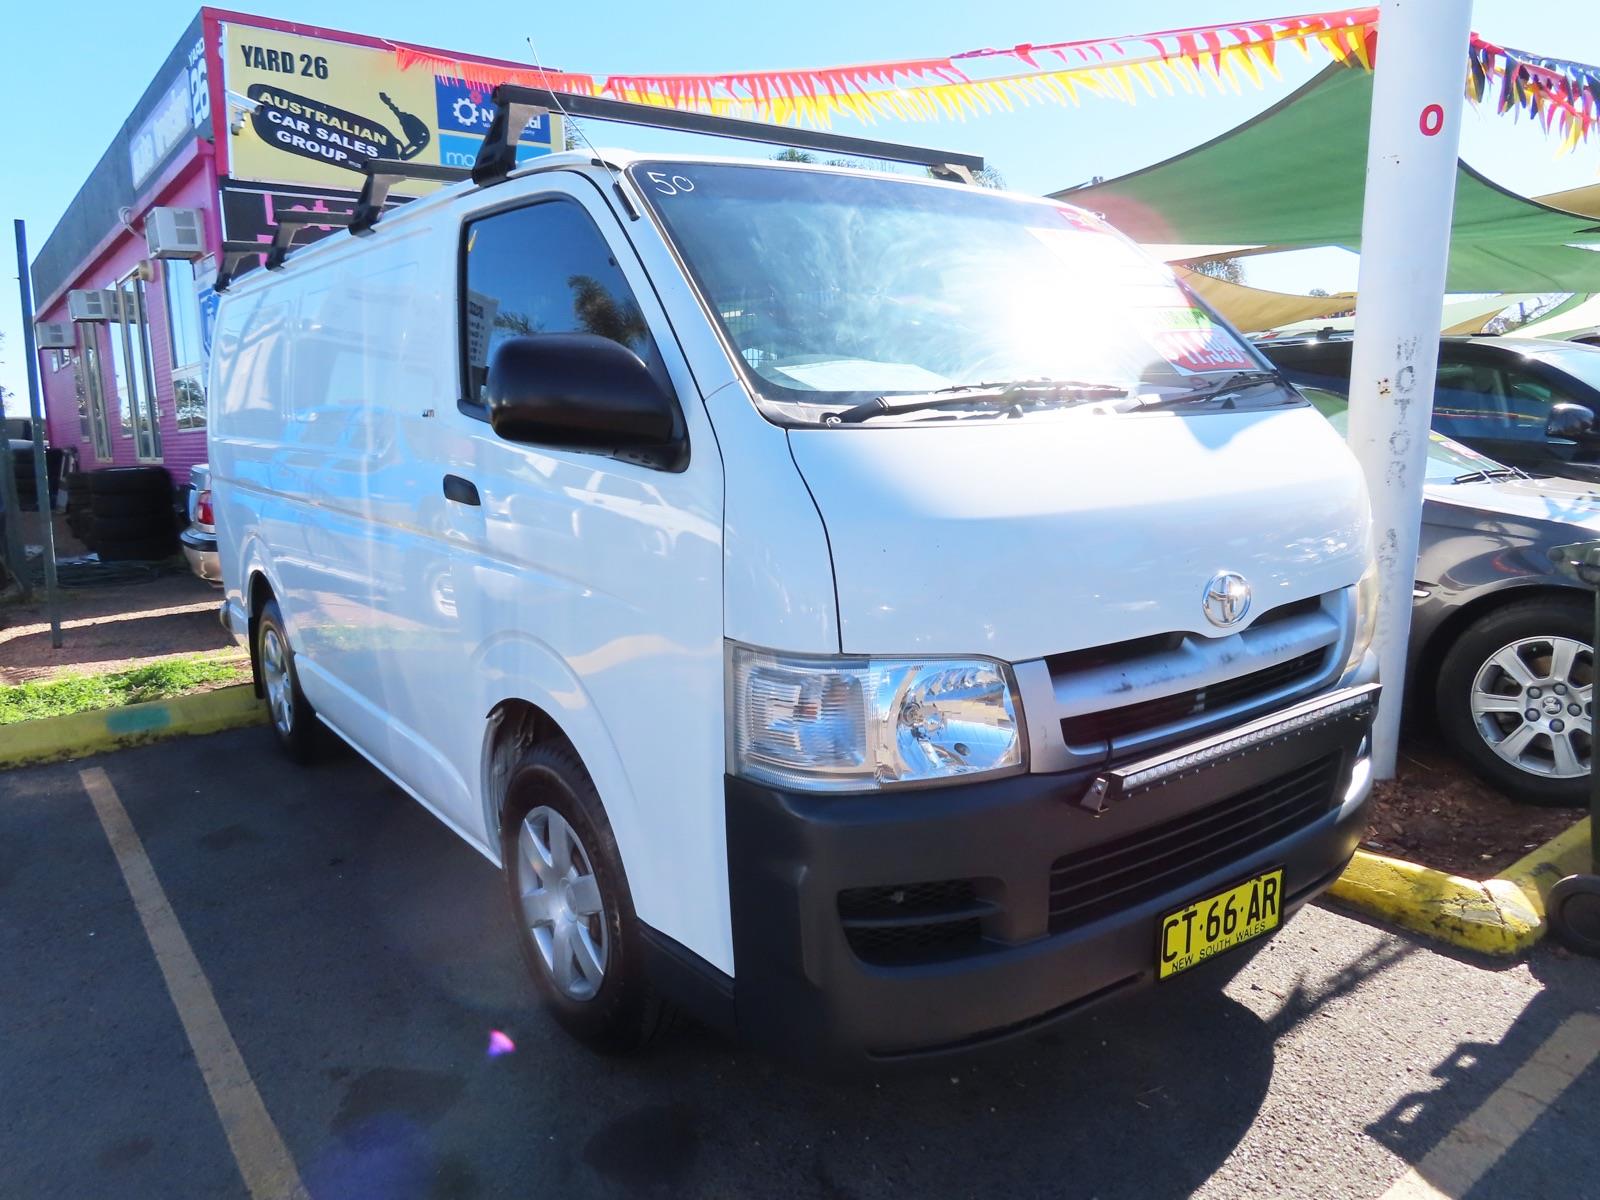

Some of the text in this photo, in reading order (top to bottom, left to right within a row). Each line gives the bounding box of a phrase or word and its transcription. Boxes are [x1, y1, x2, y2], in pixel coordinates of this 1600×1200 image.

[188, 36, 206, 67] YARD
[240, 44, 296, 75] YARD
[299, 53, 329, 80] 26
[190, 57, 211, 130] 26
[258, 91, 388, 146] AUSTRALIAN
[267, 110, 379, 158] CAR SALES
[276, 129, 348, 162] GROUP
[646, 171, 696, 196] 50
[1171, 920, 1266, 972] NEW SOUTH WALES
